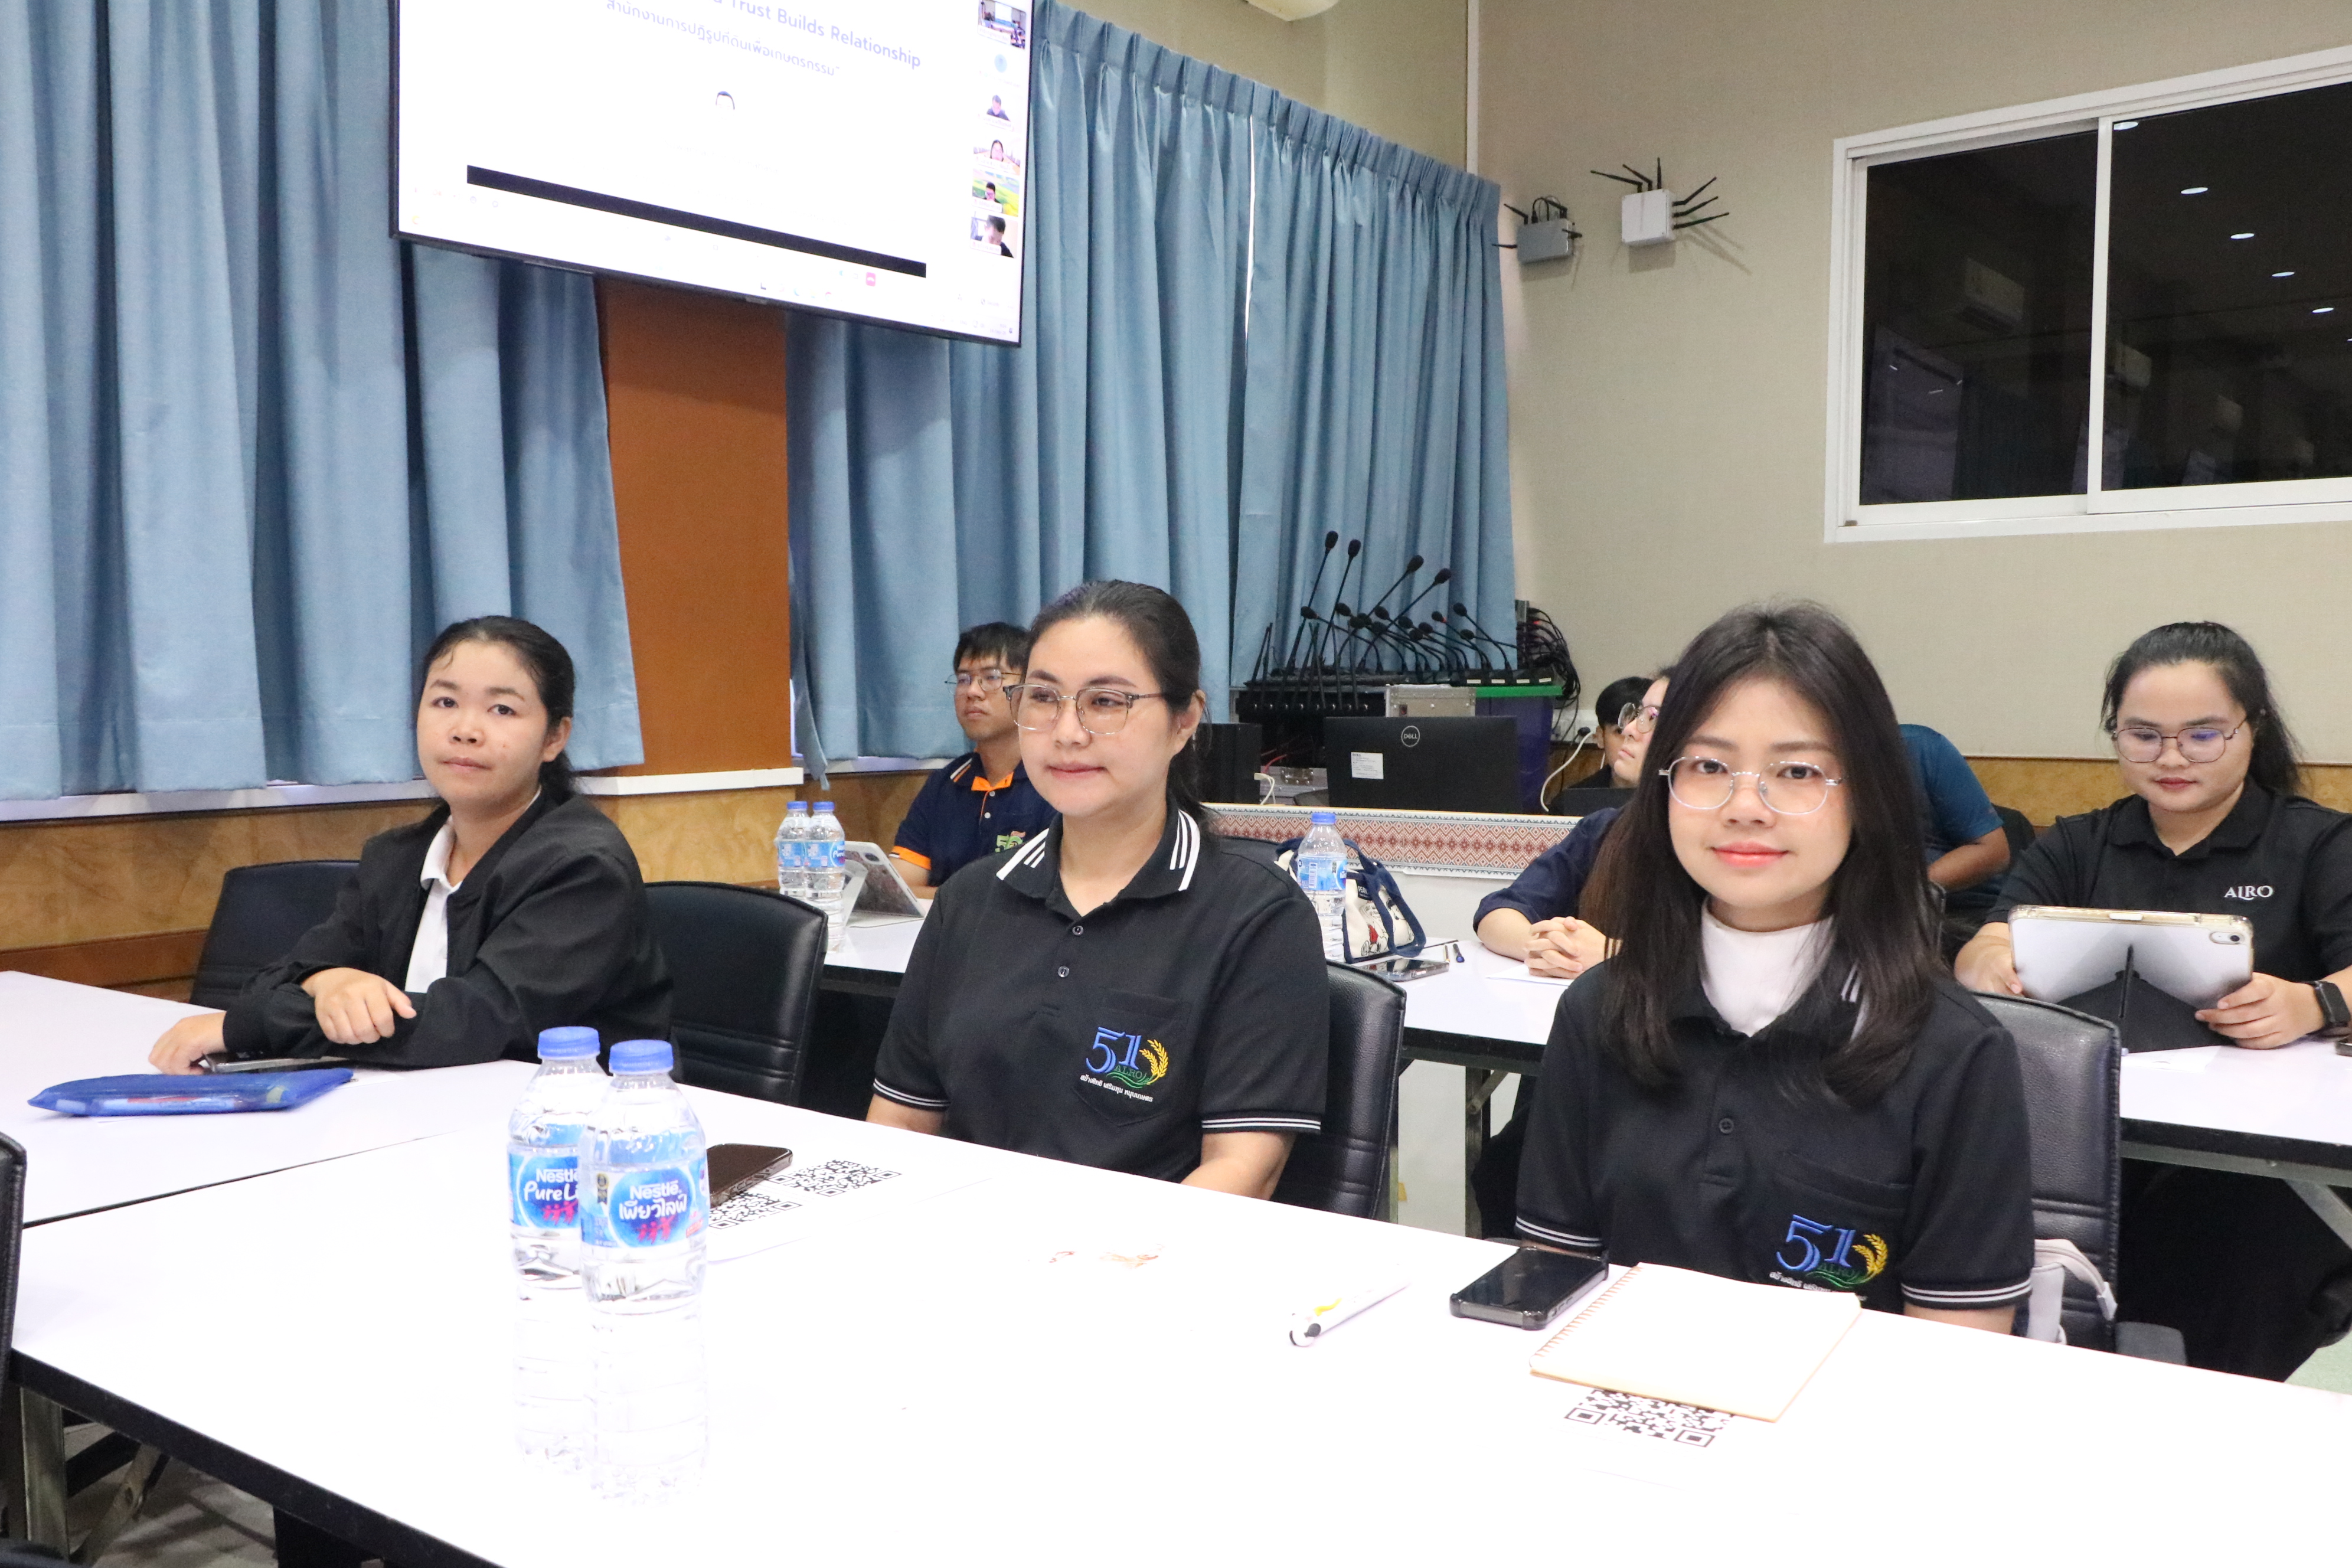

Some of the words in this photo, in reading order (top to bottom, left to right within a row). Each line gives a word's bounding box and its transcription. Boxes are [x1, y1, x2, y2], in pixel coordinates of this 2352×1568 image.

[778, 8, 825, 37] Builds
[831, 25, 922, 69] Relationship
[2223, 885, 2274, 901] ALRO
[1086, 1027, 1142, 1074] 51
[524, 1180, 563, 1201] Pure
[629, 1180, 680, 1200] Nestlé
[1776, 1214, 1856, 1272] 51
